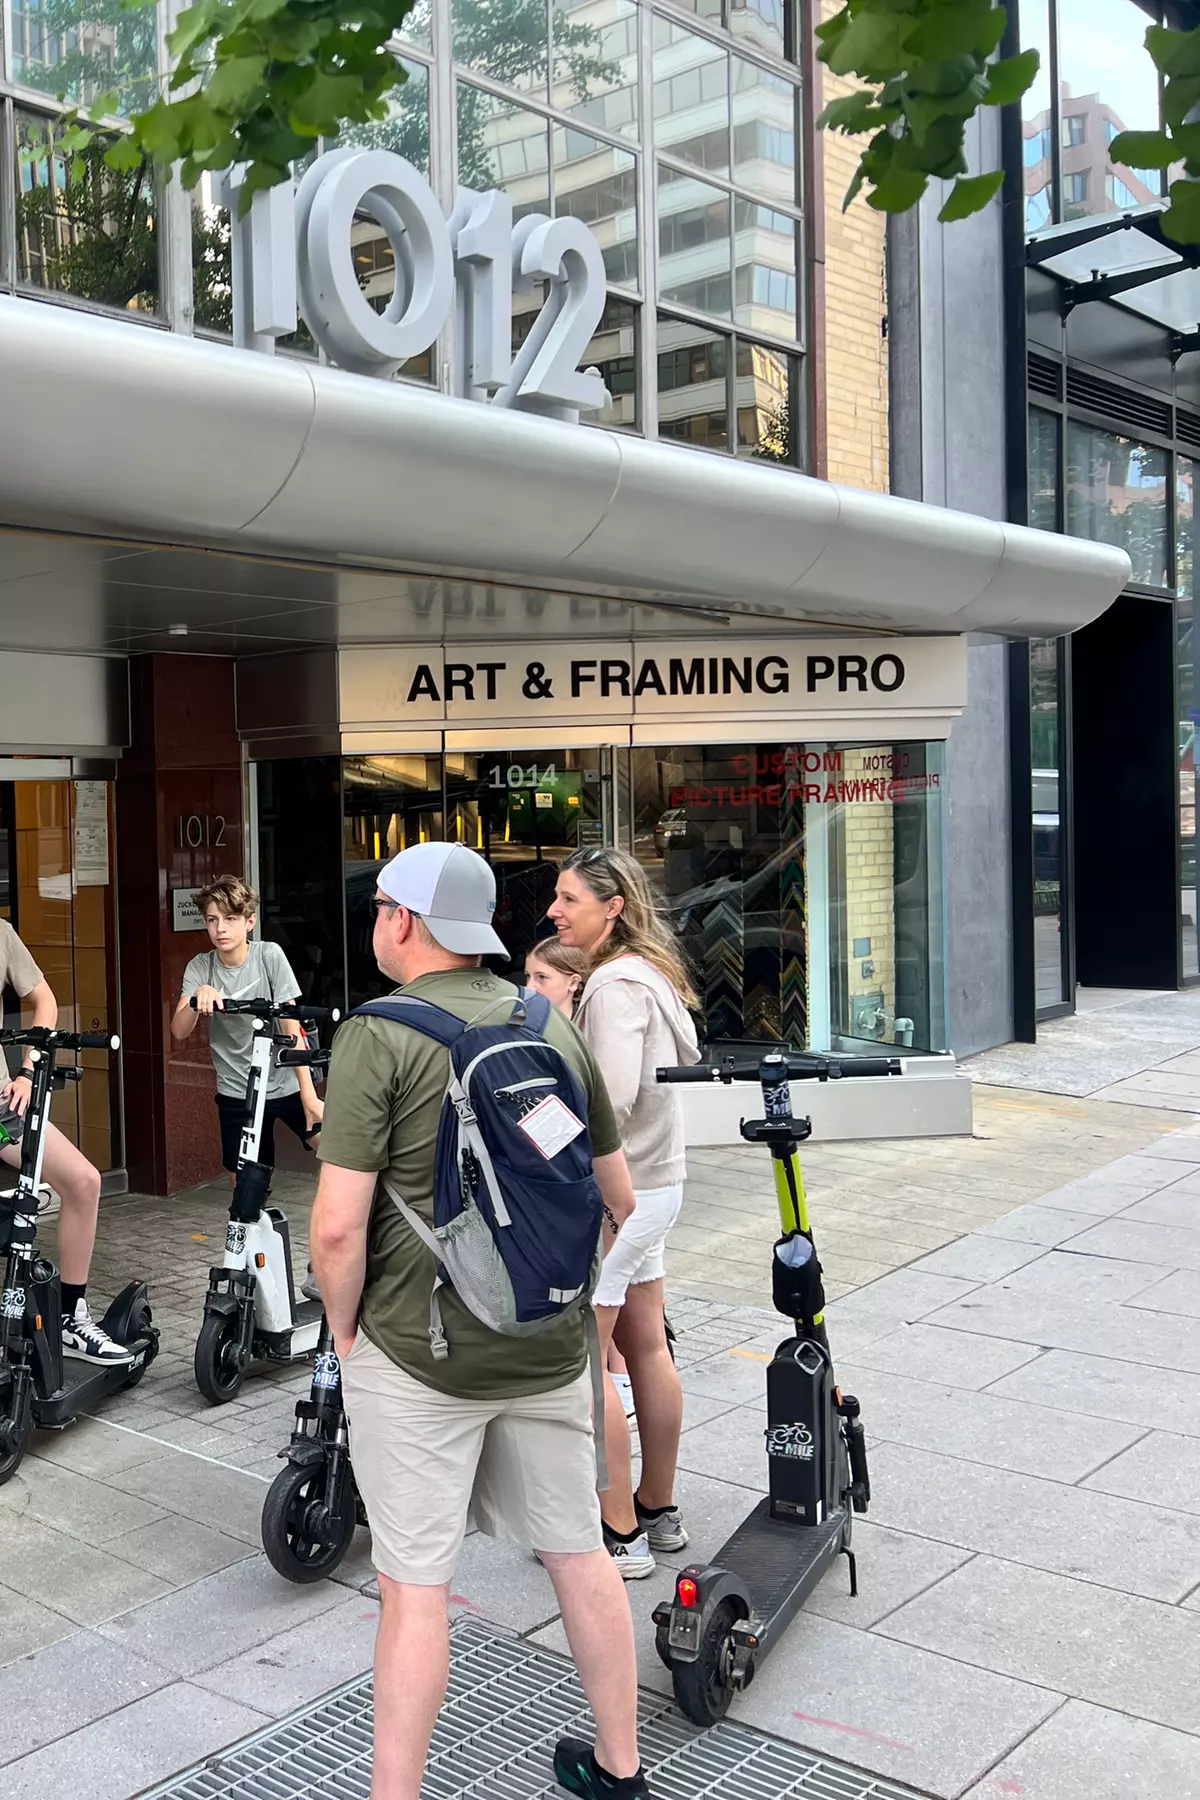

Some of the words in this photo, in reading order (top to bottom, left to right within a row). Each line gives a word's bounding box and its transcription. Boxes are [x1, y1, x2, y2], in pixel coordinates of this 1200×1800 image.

[215, 149, 608, 412] 1012
[407, 660, 507, 703] ART
[522, 659, 554, 701] &
[569, 654, 790, 699] FRAMING
[804, 652, 906, 694] PRO
[488, 763, 559, 789] 1014
[732, 751, 842, 775] CUSTOM
[671, 784, 781, 808] PICTURE
[789, 779, 905, 804] FRAMING
[180, 815, 227, 848] 1012
[768, 1440, 814, 1457] E-MILE
[612, 1545, 629, 1557] KA
